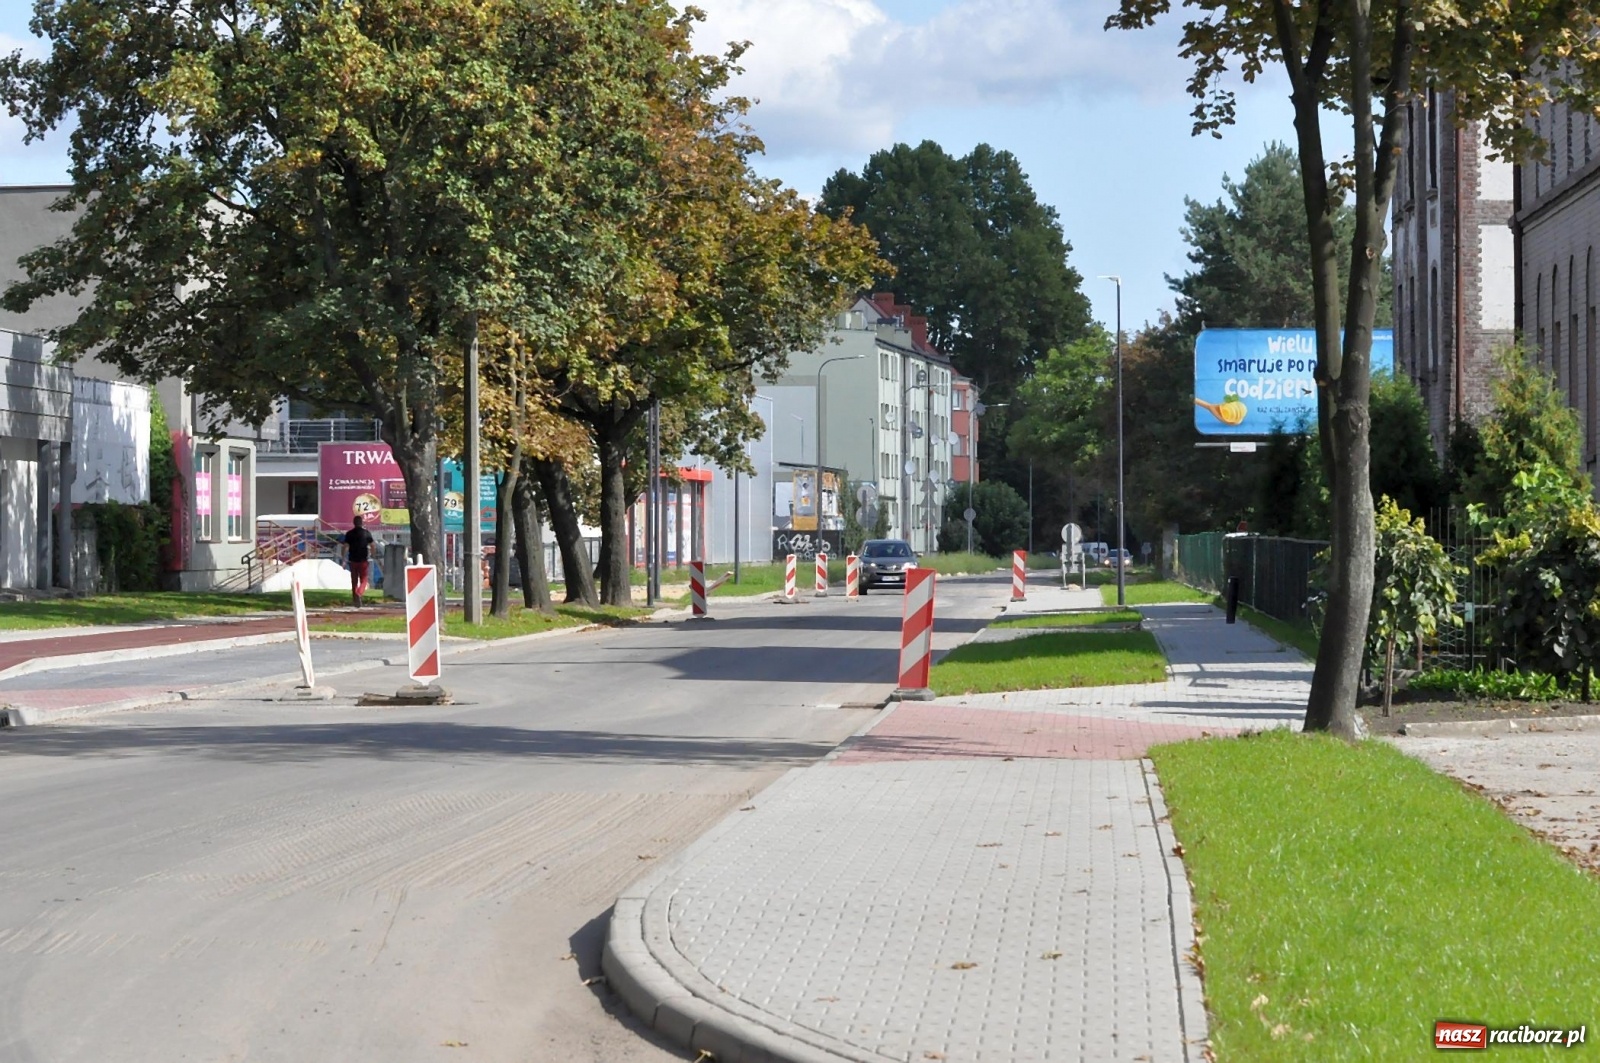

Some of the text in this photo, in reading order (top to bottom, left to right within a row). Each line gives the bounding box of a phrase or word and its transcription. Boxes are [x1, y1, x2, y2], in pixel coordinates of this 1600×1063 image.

[1267, 334, 1313, 354] Wielu
[1218, 358, 1318, 373] smaruje po n
[444, 498, 457, 508] 79
